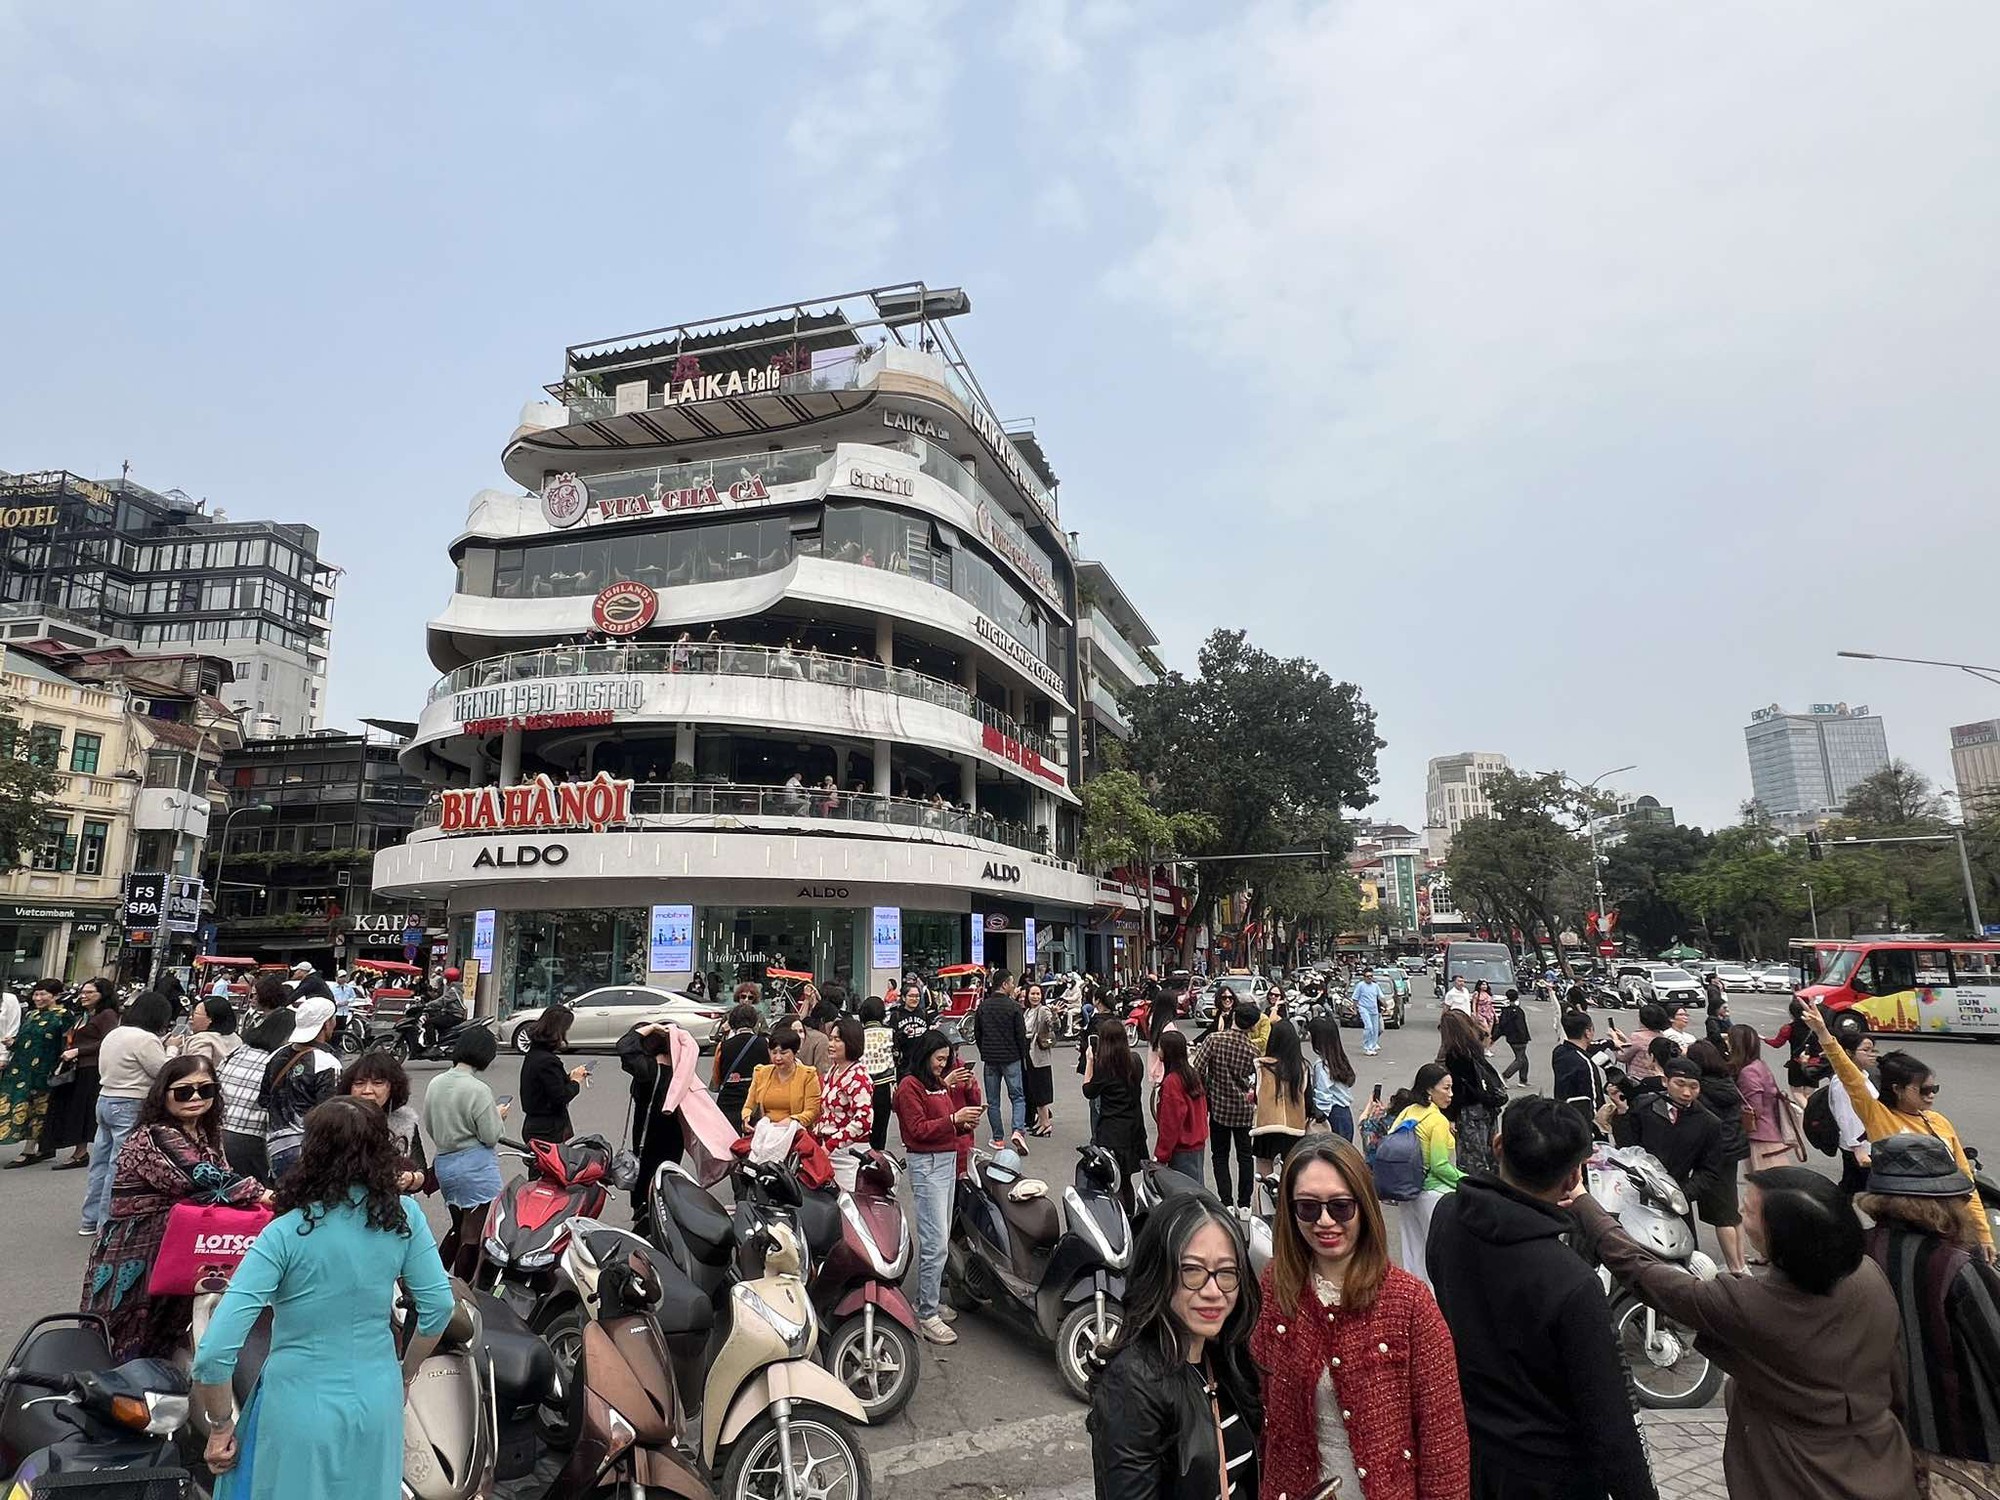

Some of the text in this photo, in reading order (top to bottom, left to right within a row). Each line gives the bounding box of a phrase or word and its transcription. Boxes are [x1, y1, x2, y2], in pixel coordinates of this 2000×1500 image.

[664, 370, 743, 406] LAIKA
[748, 364, 780, 392] Café
[883, 409, 936, 437] LAIKA
[972, 403, 1007, 464] LAIKA
[597, 474, 770, 520] VUA CHẢ CÁ
[595, 584, 653, 609] HIGHLANDS
[602, 616, 646, 632] COFFEE
[977, 616, 1064, 694] HIGHLANDS COFFEE
[508, 683, 558, 715] 1930
[565, 679, 644, 714] BISTRO
[525, 710, 615, 732] RESTAURANT
[440, 771, 634, 833] BIA HÀ NỘI
[472, 844, 569, 868] ALDO
[981, 861, 1021, 883] ALDO
[135, 886, 155, 898] FS
[797, 886, 849, 899] ALDO
[15, 907, 76, 918] Vietcombank
[129, 902, 158, 914] SPA
[77, 924, 97, 932] ATM
[368, 933, 401, 945] Café
[739, 950, 767, 963] Minh
